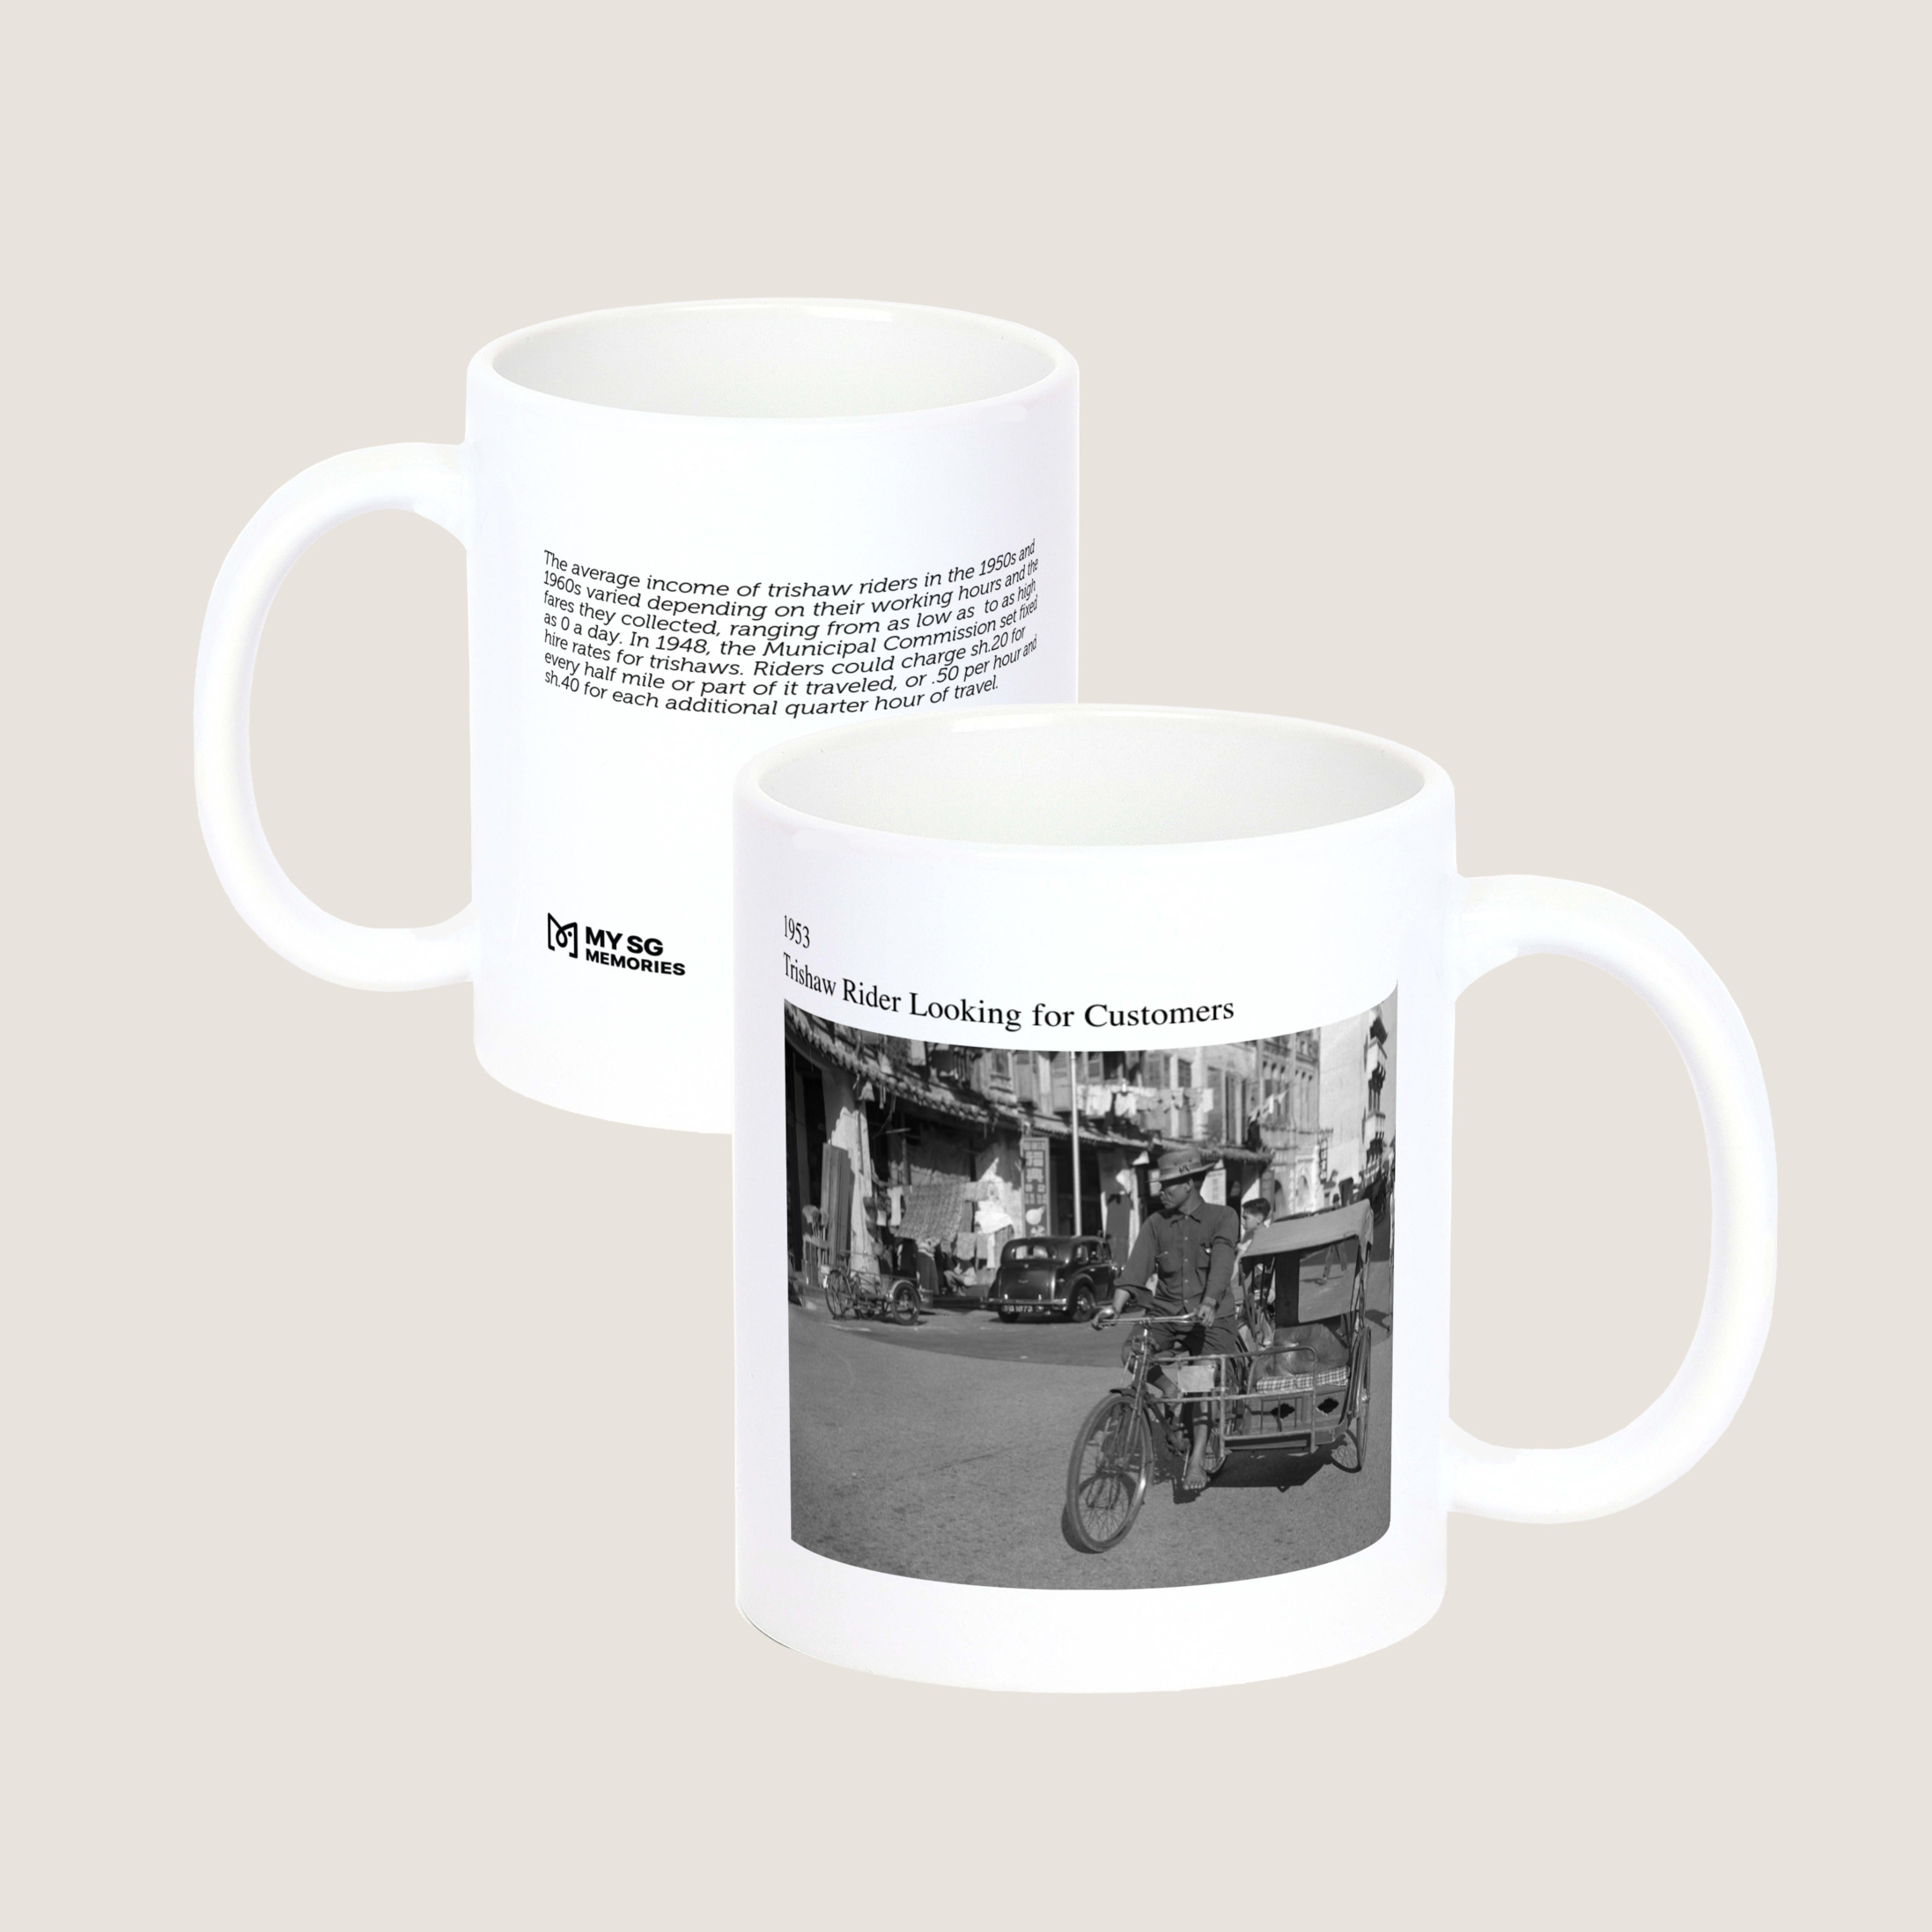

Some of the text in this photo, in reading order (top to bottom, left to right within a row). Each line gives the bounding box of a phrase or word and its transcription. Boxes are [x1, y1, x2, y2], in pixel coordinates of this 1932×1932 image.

[543, 558, 1038, 621] 1960s varied depending on their working hours and the
[544, 538, 1035, 597] The average income of trishaw riders in the 1950s and
[544, 579, 1036, 641] fares they collected, ranging from as low as to as high
[544, 594, 1038, 659] as 0 a day. In 1948, the Municipal Commission set fixed
[544, 626, 1026, 676] hire rates for trishaws. Riders could charge sh.20 for
[545, 634, 1036, 697] every half mile or part of it traveled, or .50 per hour and
[545, 670, 998, 719] sh.40 for each additional quarter hour of travel.
[586, 926, 663, 956] MY SG
[785, 915, 810, 948] 1953
[586, 948, 686, 976] MEMORIES
[784, 952, 1234, 1032] Trishaw Rider Looking for Customers
